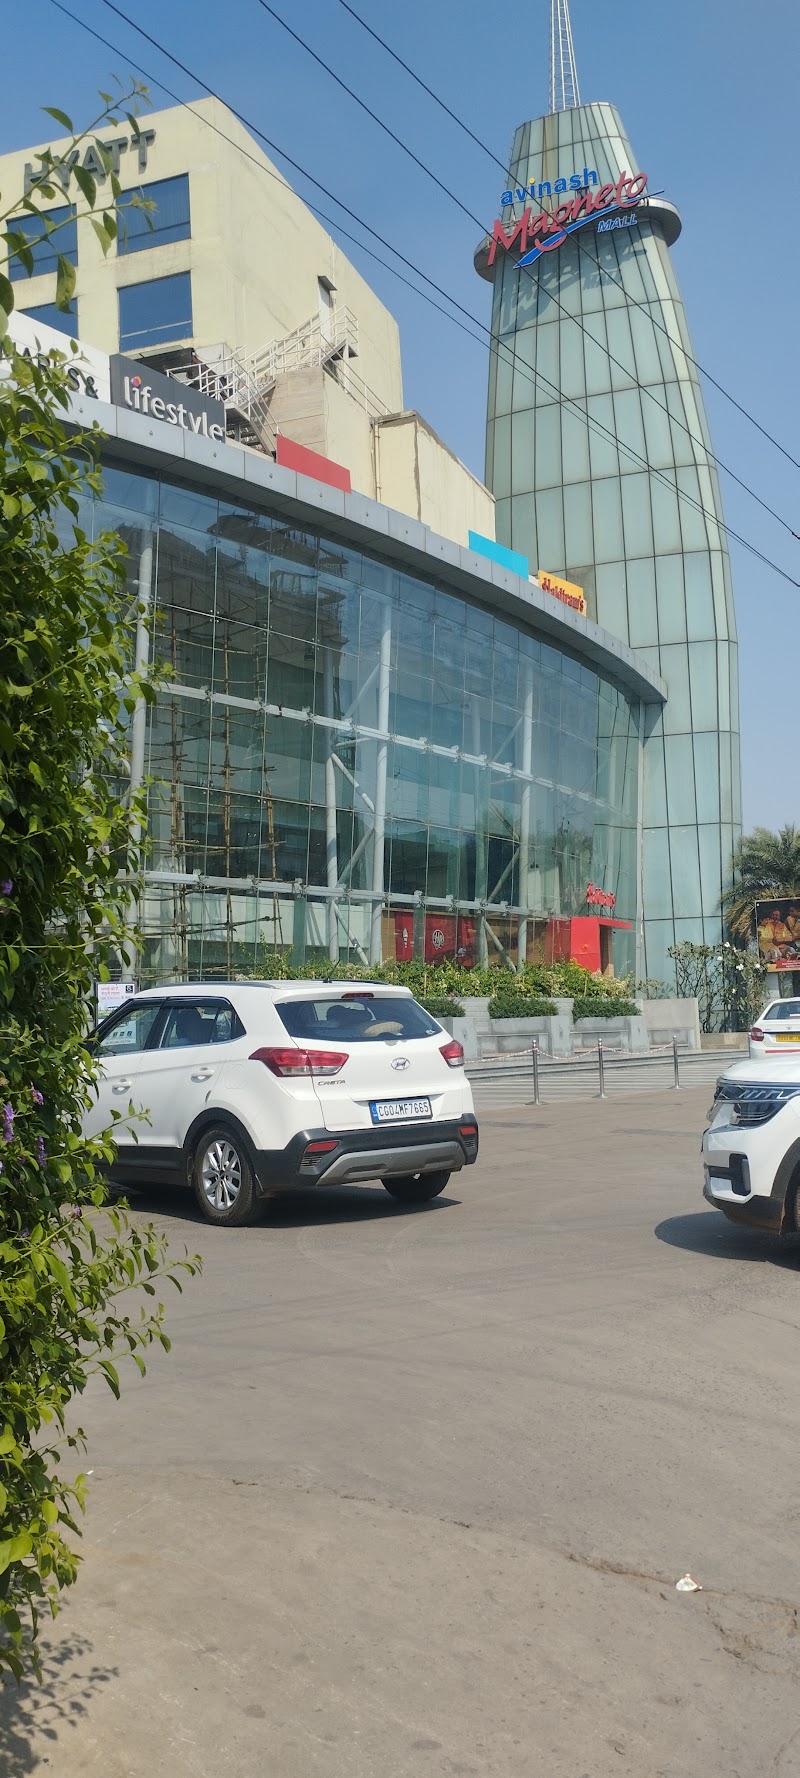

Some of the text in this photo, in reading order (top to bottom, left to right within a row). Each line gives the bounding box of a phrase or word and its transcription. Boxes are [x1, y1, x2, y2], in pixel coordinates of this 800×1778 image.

[23, 129, 156, 196] HYATT
[500, 167, 598, 207] avinash
[487, 170, 648, 266] Magneto
[597, 213, 638, 233] MALL
[85, 375, 99, 399] &
[123, 375, 226, 441] lifestyle
[378, 1102, 429, 1117] CG04MF7665
